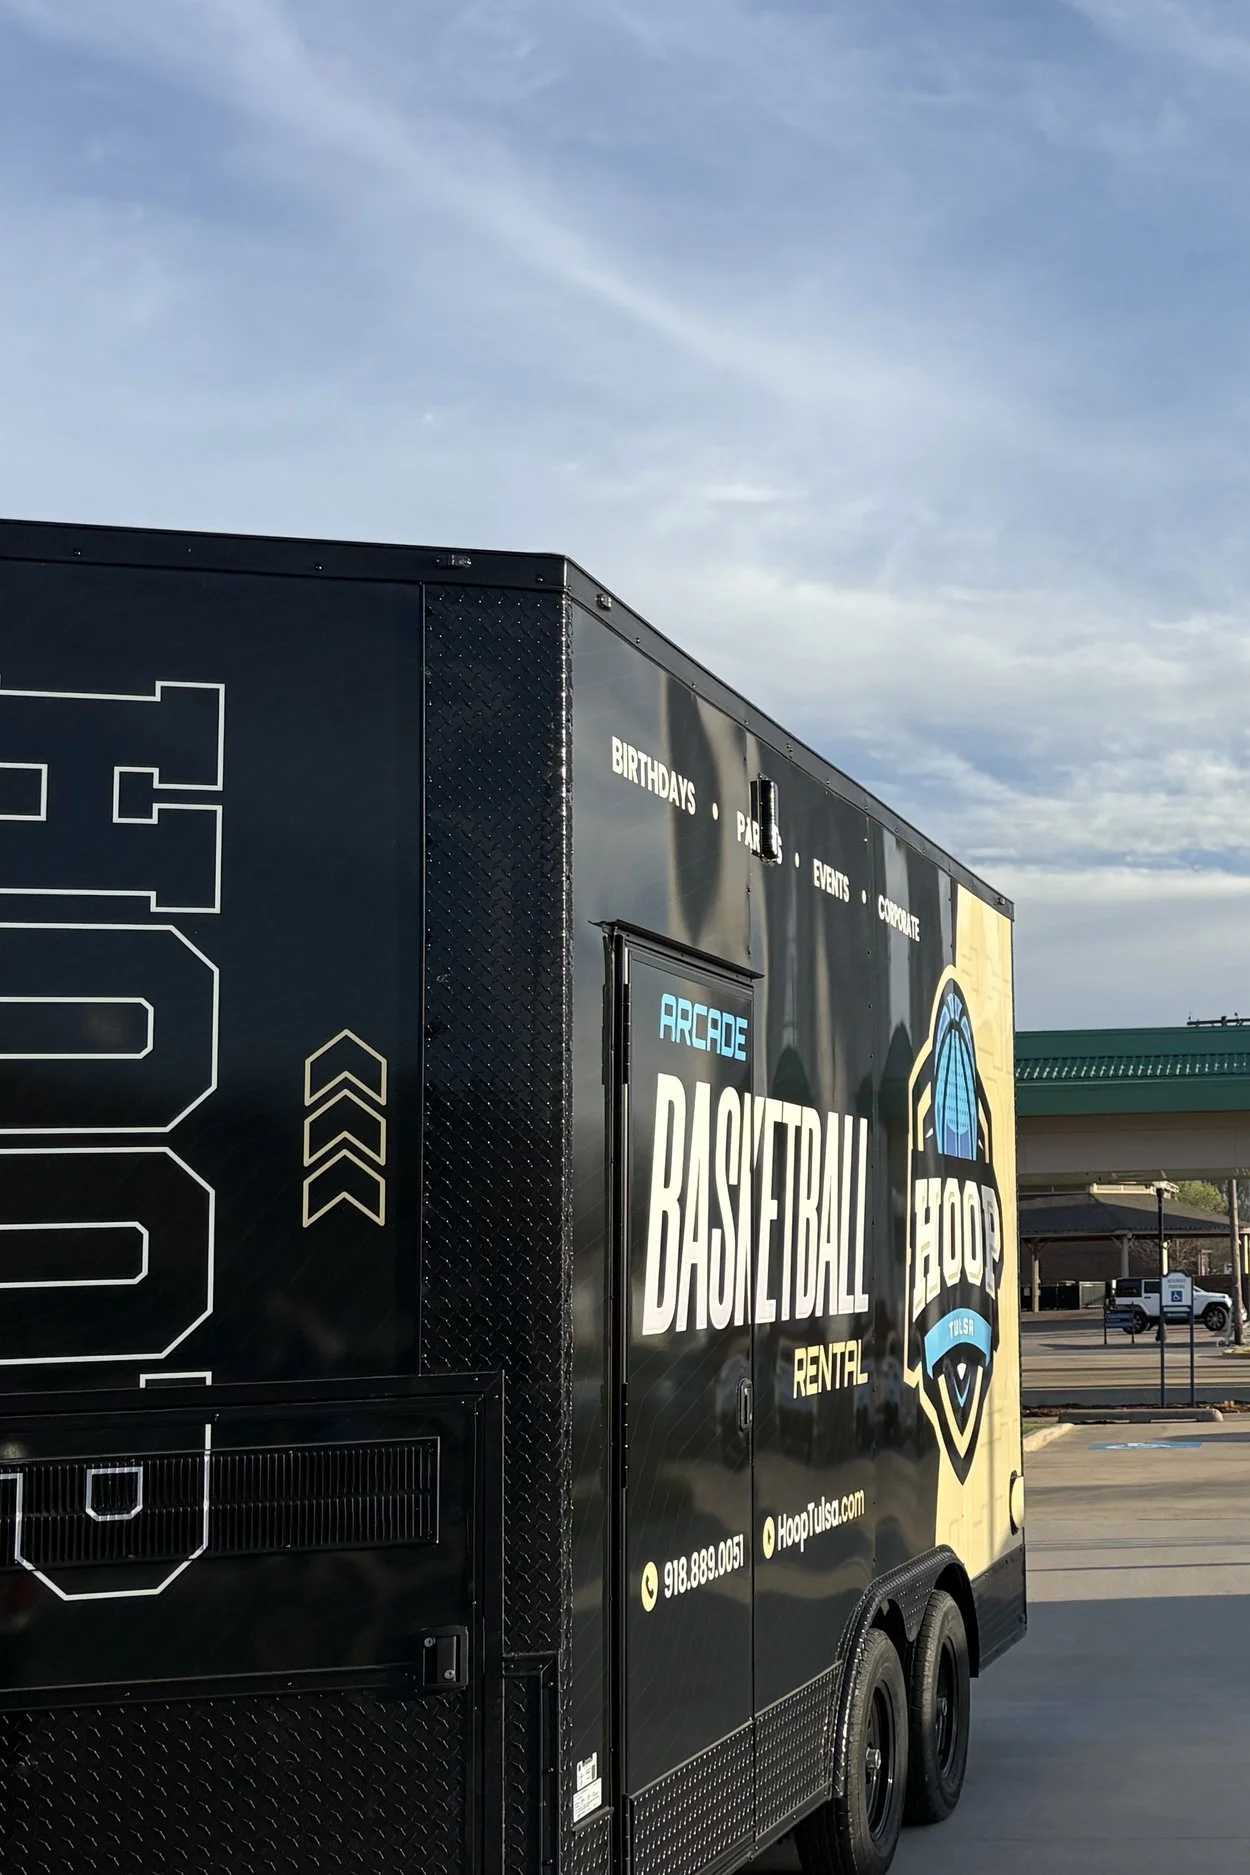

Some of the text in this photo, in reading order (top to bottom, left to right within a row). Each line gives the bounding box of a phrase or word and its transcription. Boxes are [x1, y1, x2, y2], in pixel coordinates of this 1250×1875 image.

[611, 735, 921, 942] BIRTHDAYS PARS EVENTS CORPORATE
[659, 992, 748, 1061] ARCADE
[641, 1072, 869, 1336] BASKETBALL
[912, 1177, 1001, 1323] HOOP
[948, 1317, 975, 1340] TULSA
[793, 1338, 869, 1399] RENTAL
[777, 1488, 865, 1553] HoopTulsa.com
[663, 1533, 744, 1599] 918.889.0051
